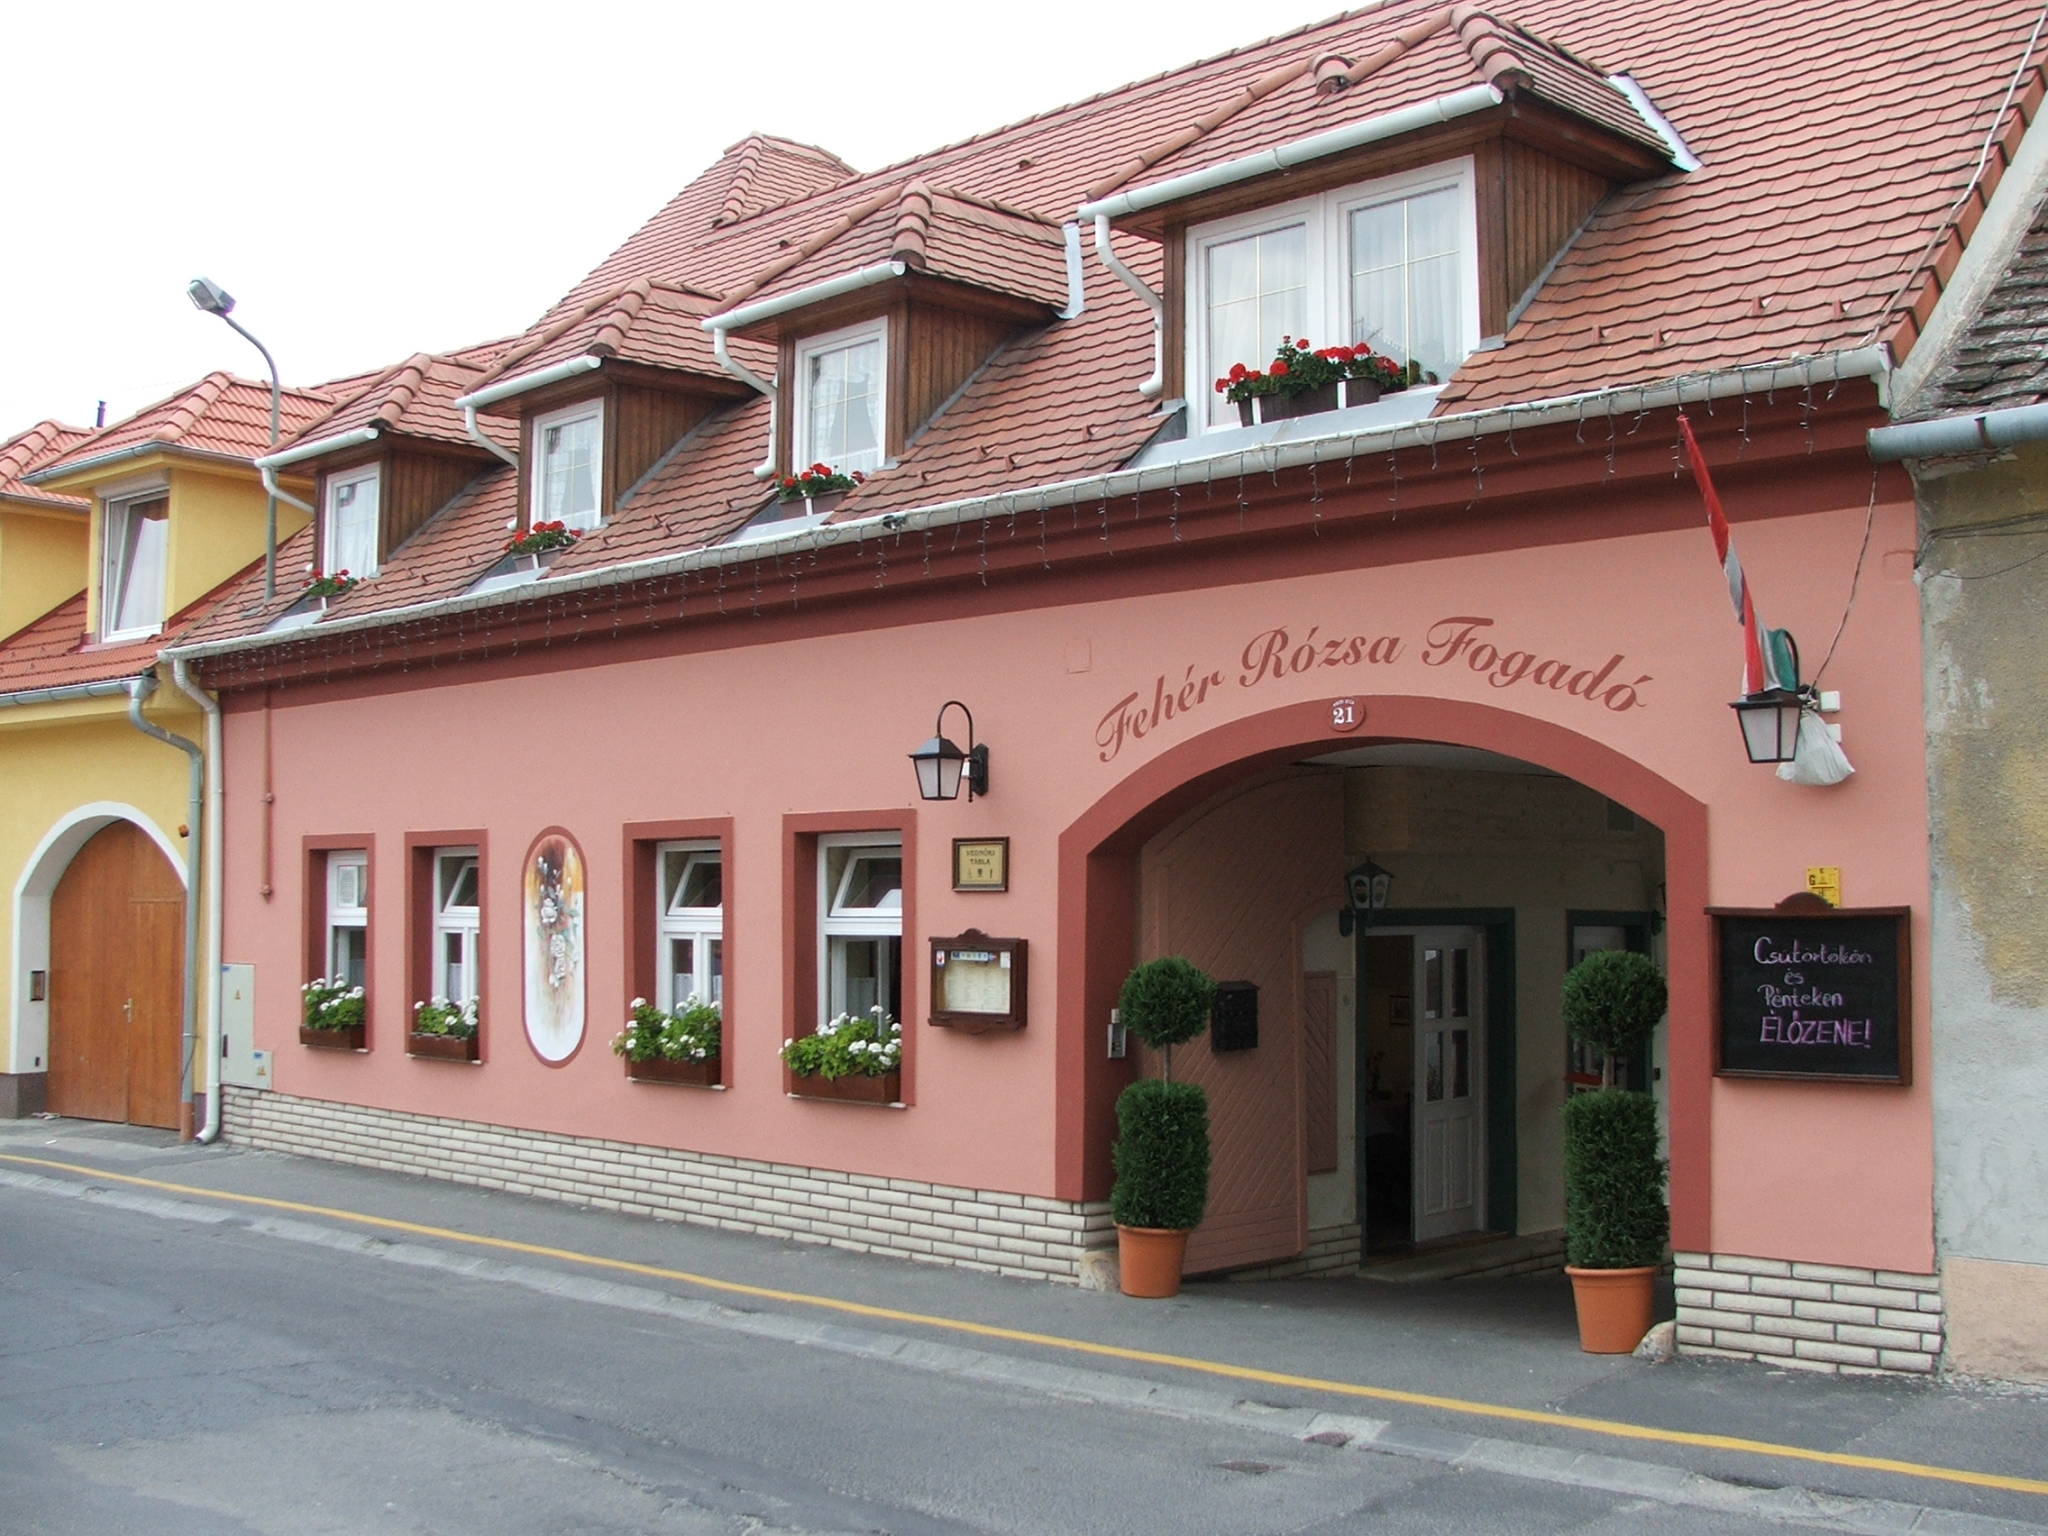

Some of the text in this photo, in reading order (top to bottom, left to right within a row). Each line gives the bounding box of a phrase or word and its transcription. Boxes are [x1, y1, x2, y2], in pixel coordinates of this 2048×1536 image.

[1095, 616, 1653, 763] Fehér Rózsa Fogadó
[1333, 706, 1353, 725] 21
